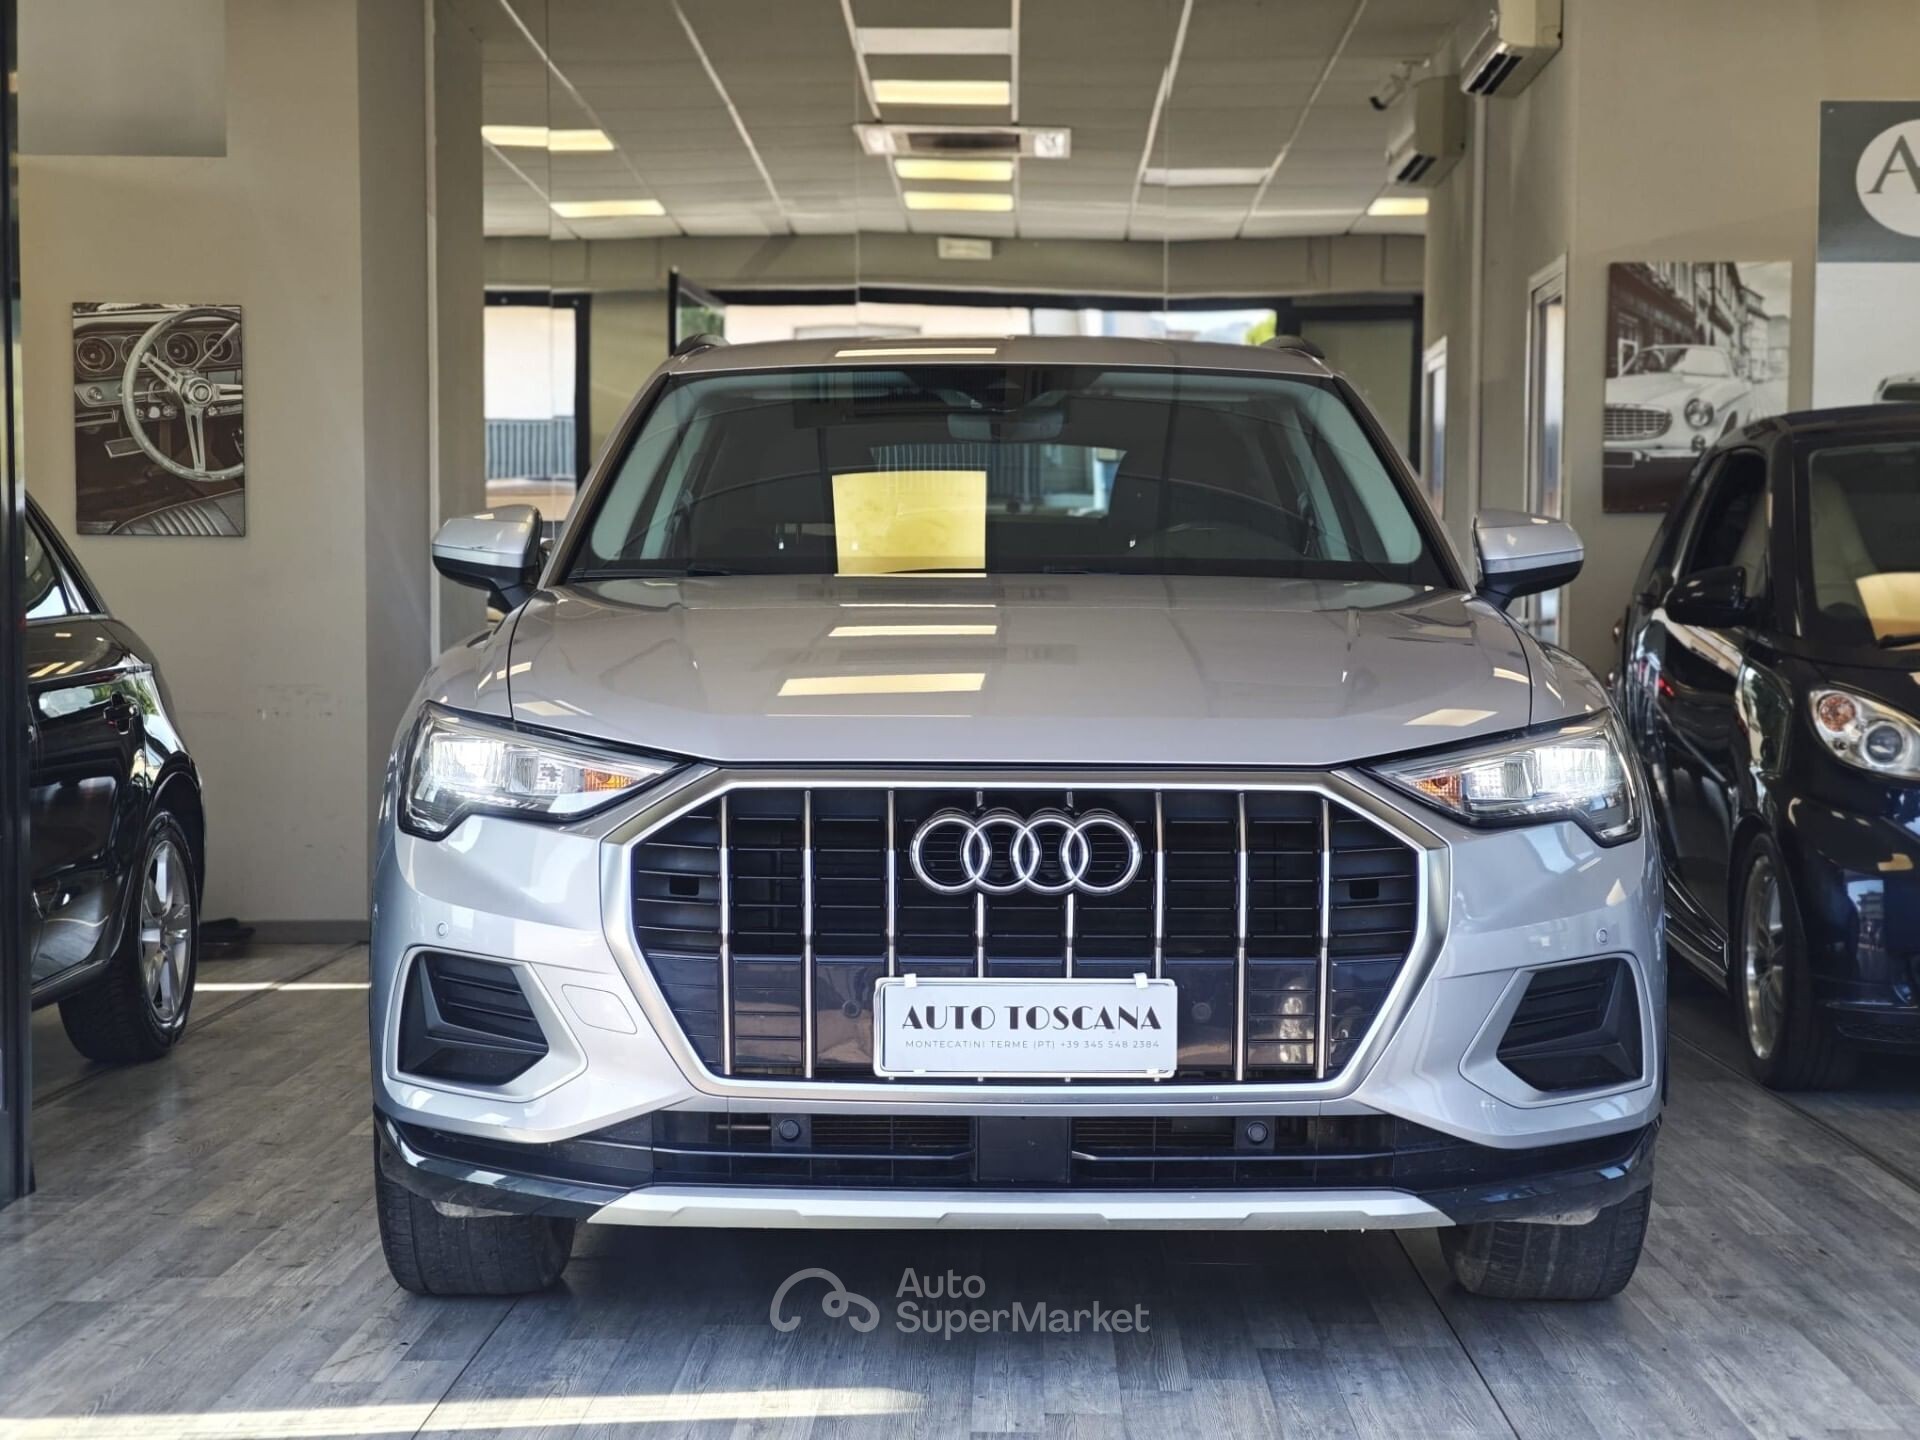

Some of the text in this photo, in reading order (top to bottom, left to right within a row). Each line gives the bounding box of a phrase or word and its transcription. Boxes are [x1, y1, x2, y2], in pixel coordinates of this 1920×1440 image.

[902, 1005, 1162, 1031] AUTO TOSCANA
[905, 1039, 1160, 1051] MONTECATINI TERME (PT) +39 345 548 2384
